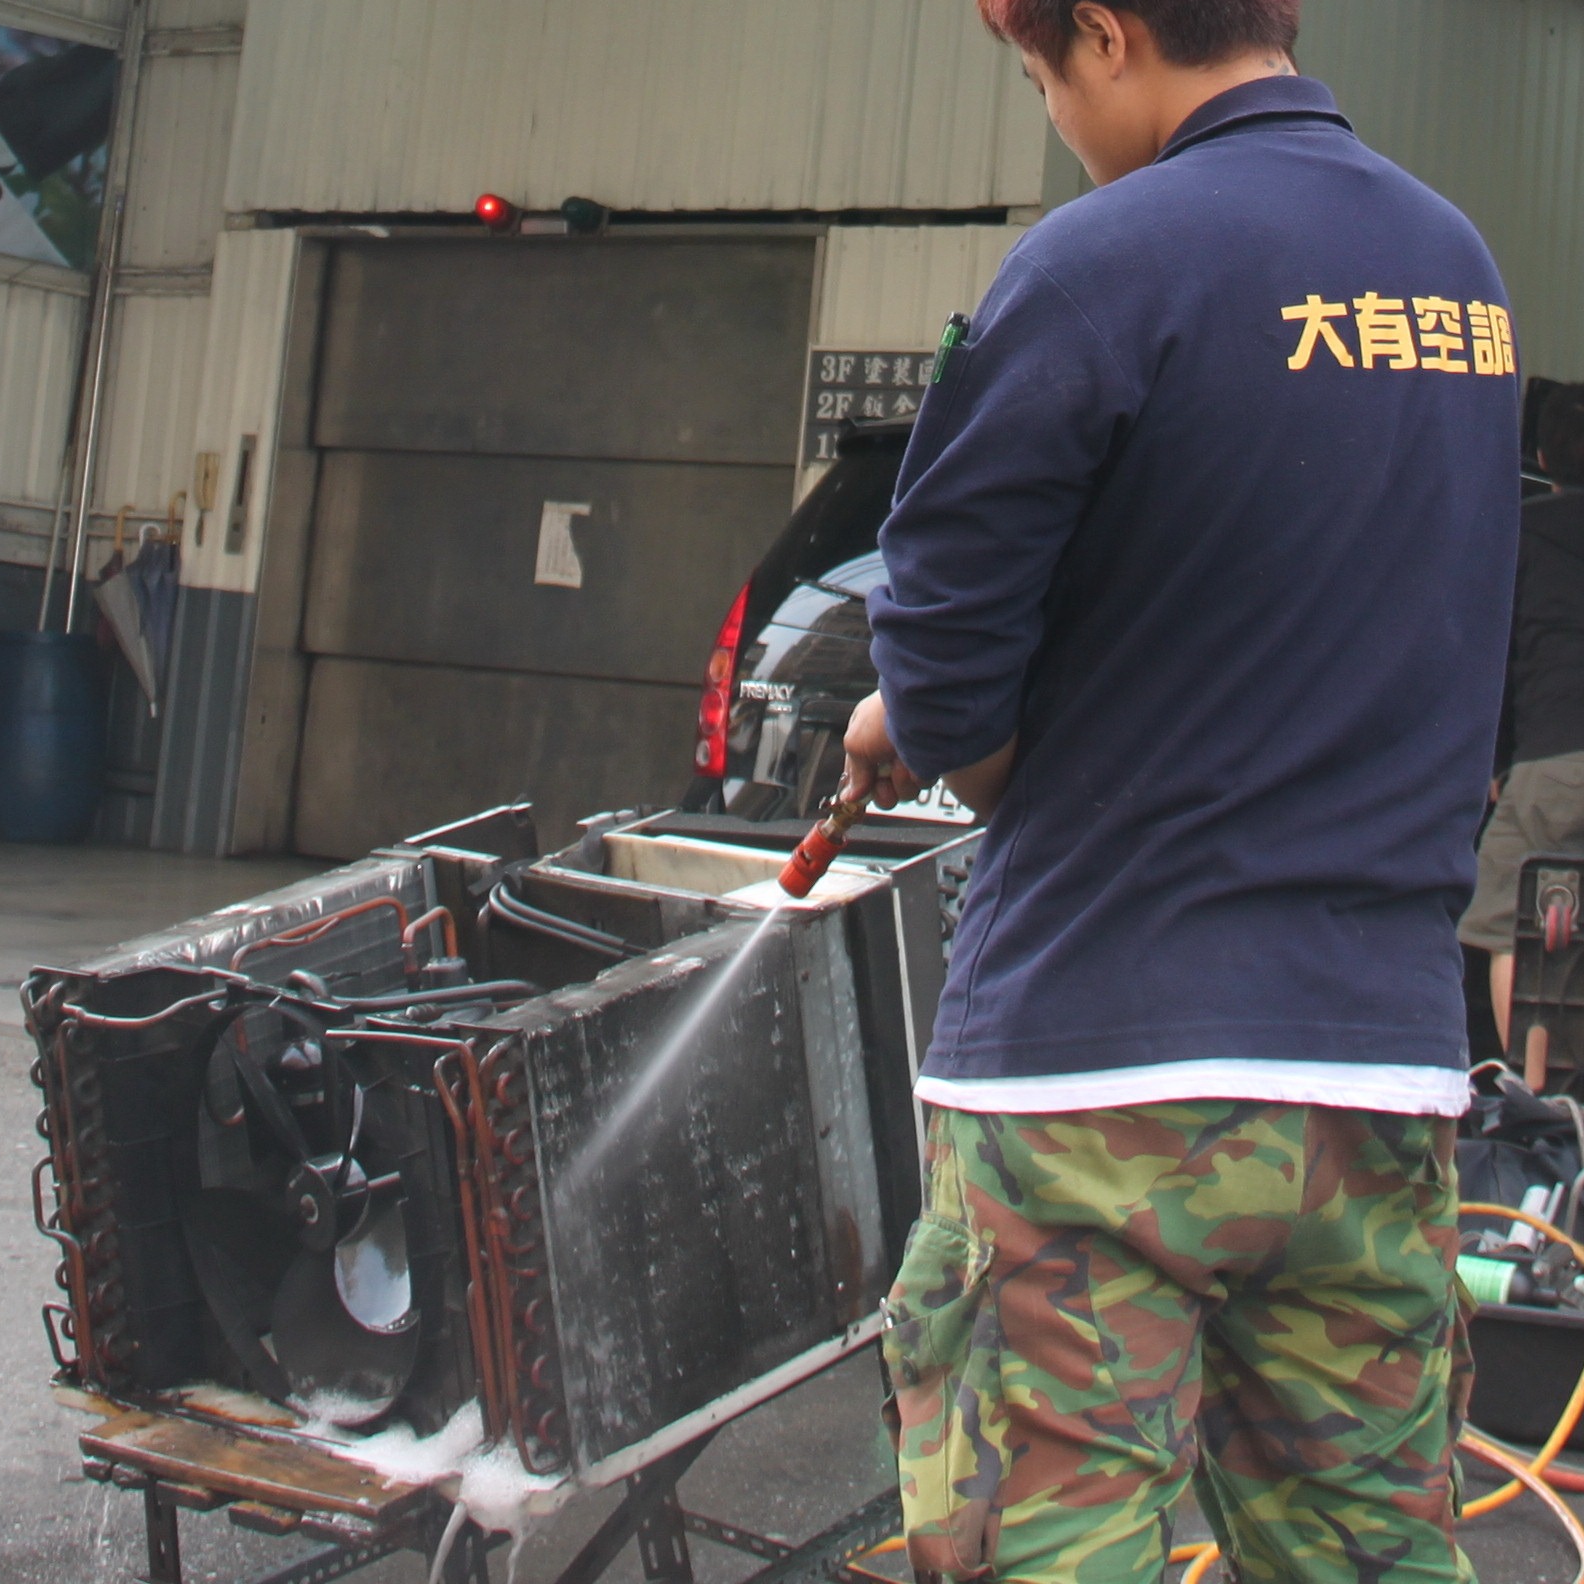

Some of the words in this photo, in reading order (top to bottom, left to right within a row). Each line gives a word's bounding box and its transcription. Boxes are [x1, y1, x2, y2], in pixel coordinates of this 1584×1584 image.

[1280, 291, 1514, 376] 大有空調
[819, 354, 855, 384] 3F
[816, 391, 854, 420] 2F
[739, 680, 796, 702] PREMACY
